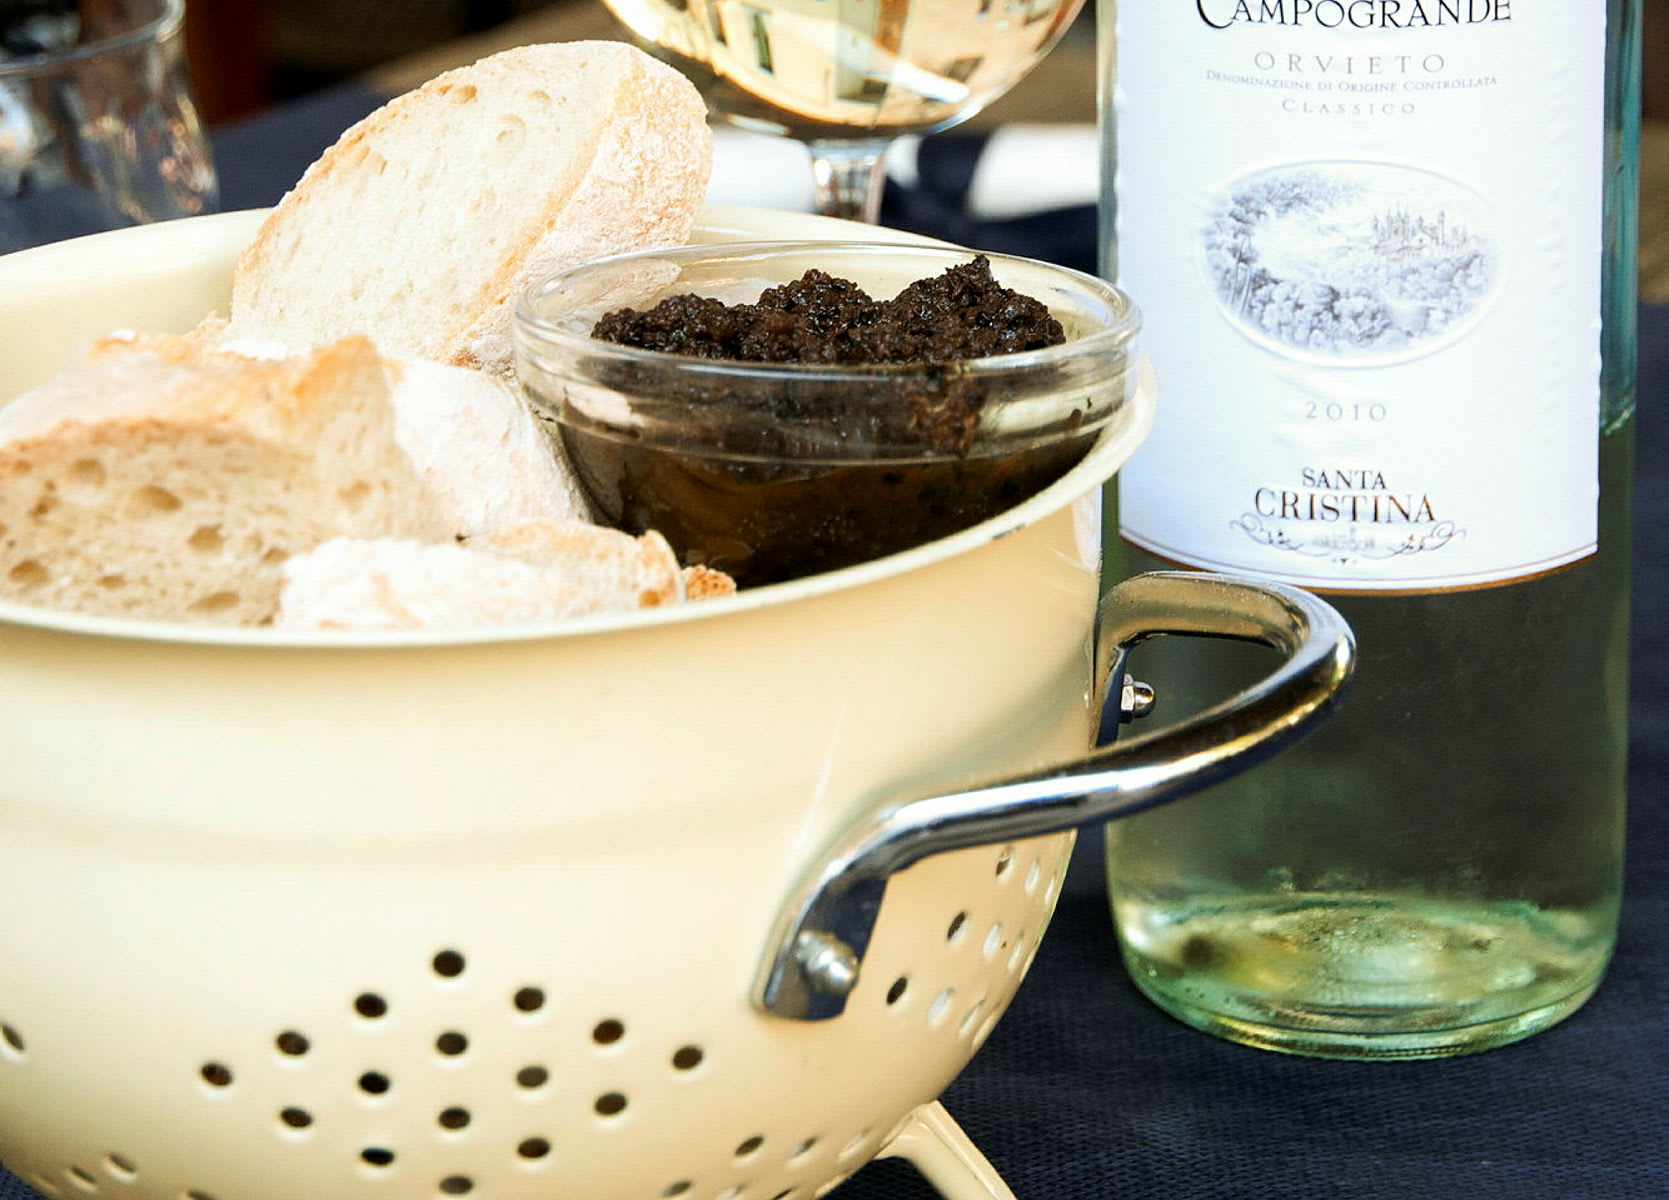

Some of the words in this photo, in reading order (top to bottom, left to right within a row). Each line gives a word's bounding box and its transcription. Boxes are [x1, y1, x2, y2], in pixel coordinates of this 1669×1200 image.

[1254, 51, 1445, 75] ORVIETO
[1206, 69, 1311, 91] DENOMINAZIONE
[1318, 81, 1332, 91] DI
[1338, 80, 1398, 93] ORIGINE
[1403, 75, 1498, 92] CONTROLLATA
[1281, 98, 1415, 115] CLASSICO
[1306, 401, 1387, 422] 2010
[1301, 466, 1388, 490] SANTA
[1254, 486, 1437, 523] CRISTINA
